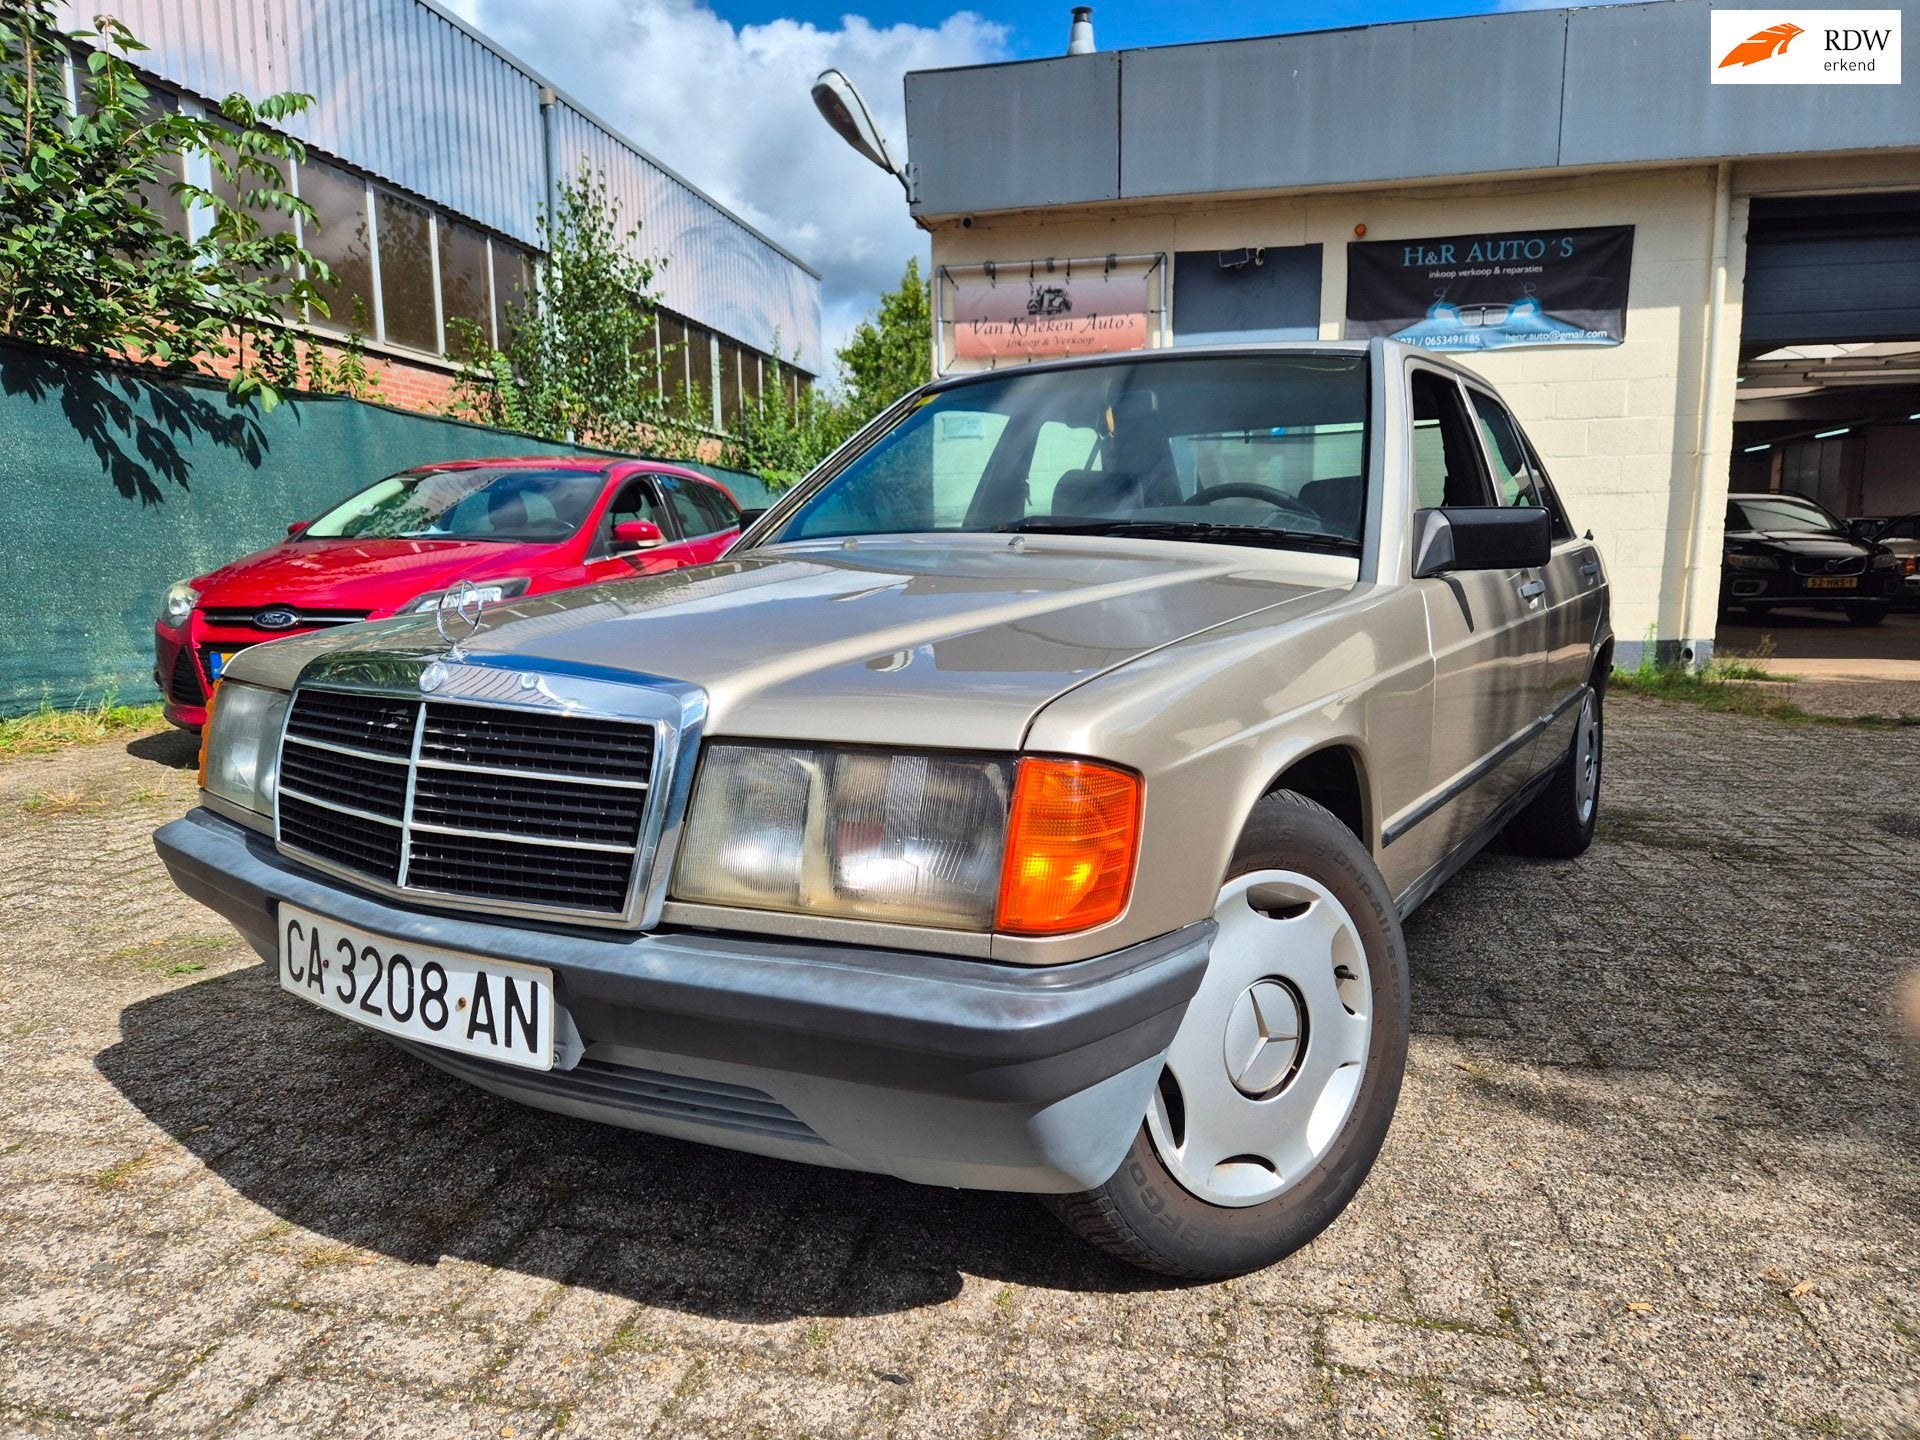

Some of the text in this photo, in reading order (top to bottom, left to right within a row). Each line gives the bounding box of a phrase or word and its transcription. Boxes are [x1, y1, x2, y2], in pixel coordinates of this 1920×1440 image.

[1403, 244, 1457, 267] H&R
[1428, 264, 1543, 279] inkoop verkoop & reparaties
[970, 316, 1004, 335] Van
[1079, 312, 1136, 334] Auto's
[1006, 339, 1041, 349] Inkoop
[1055, 335, 1095, 346] Verkoop
[1424, 334, 1481, 346] 0653491185
[261, 612, 286, 624] Ford
